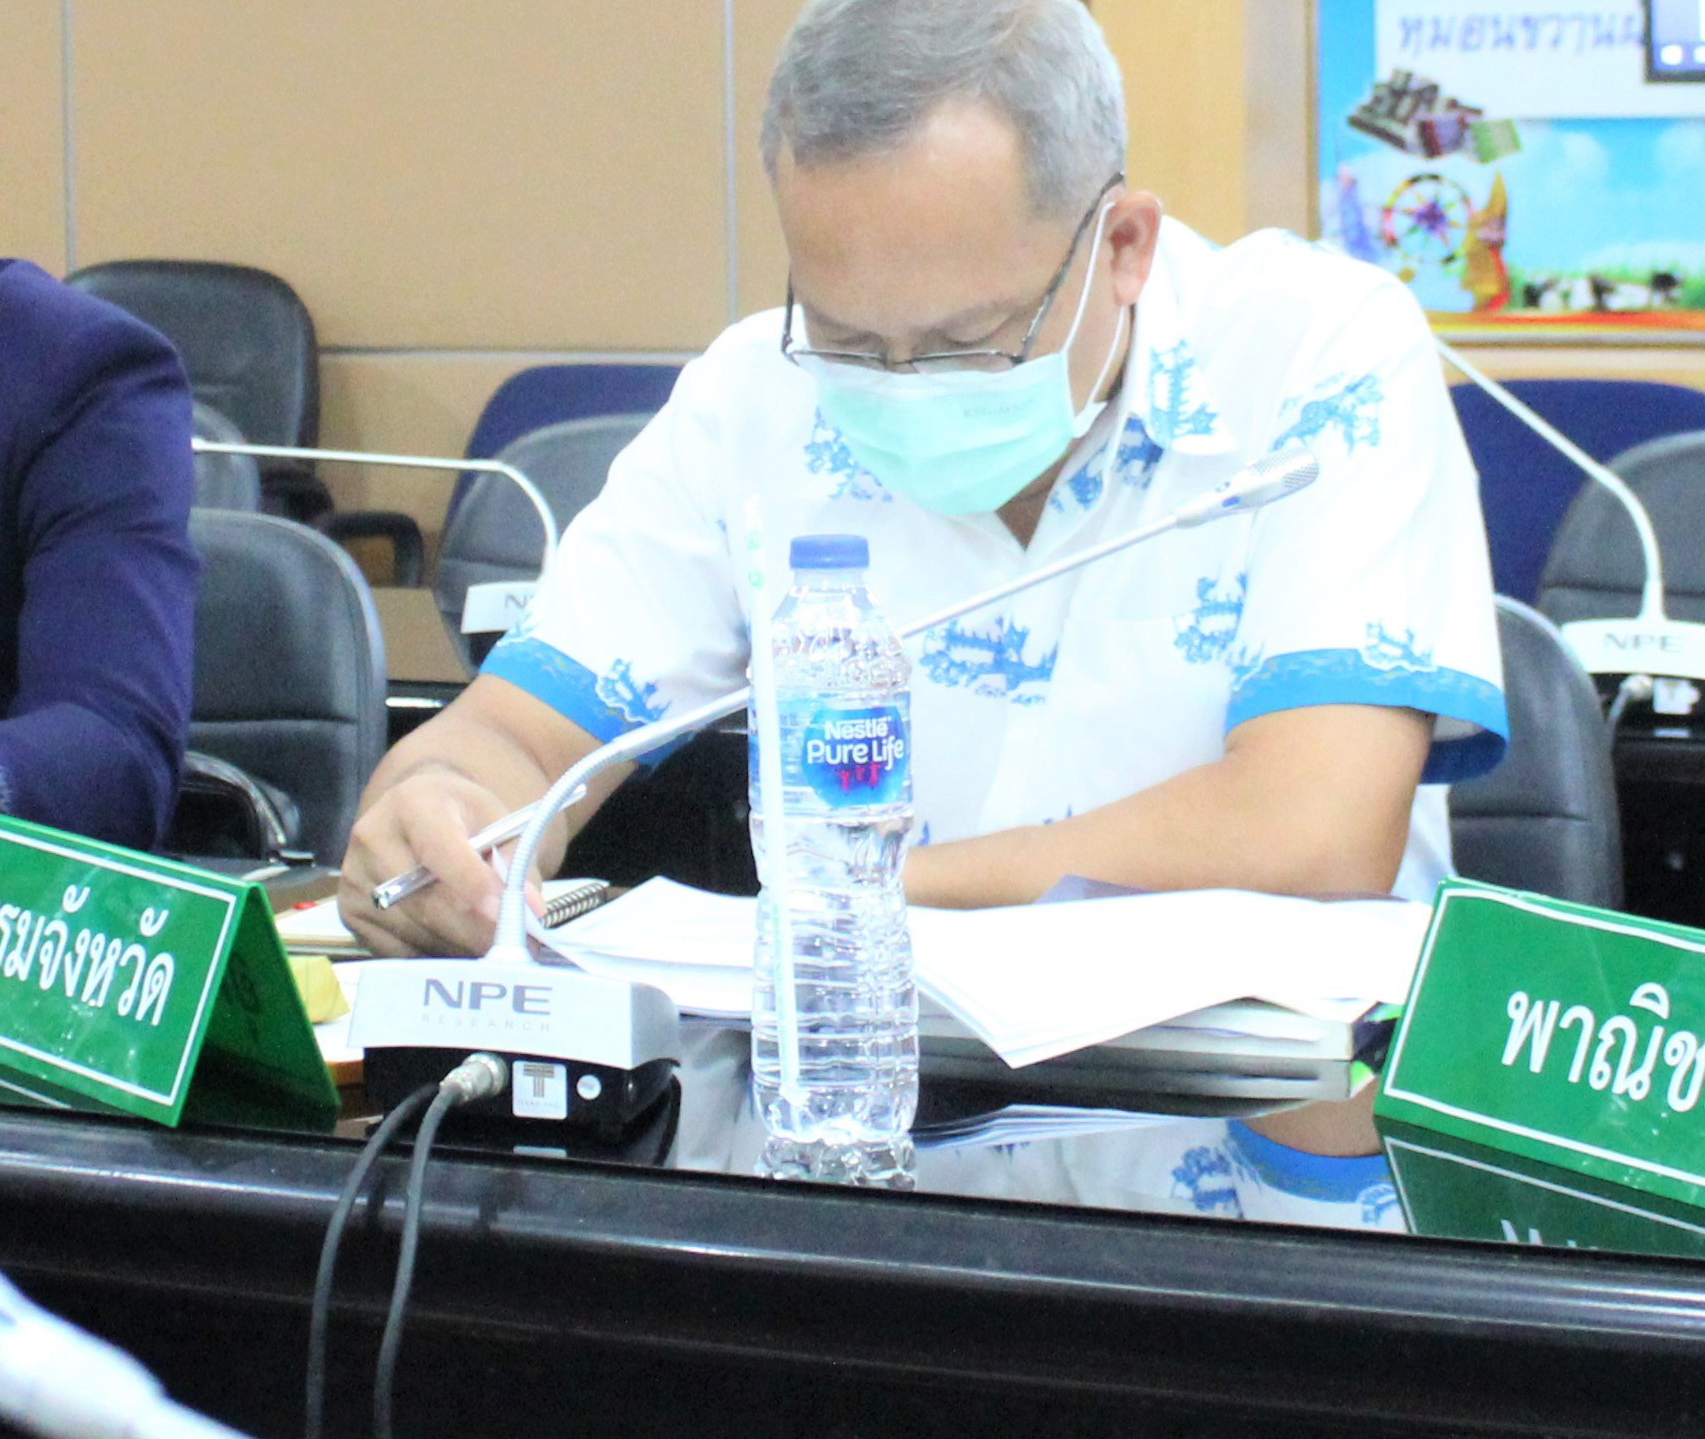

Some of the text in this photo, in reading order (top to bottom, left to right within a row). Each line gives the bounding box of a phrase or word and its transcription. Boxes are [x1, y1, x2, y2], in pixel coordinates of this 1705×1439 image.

[1604, 633, 1681, 653] NPE
[807, 735, 904, 771] Pure Life
[423, 978, 553, 1015] NPE
[421, 1013, 551, 1031] RESEARCH
